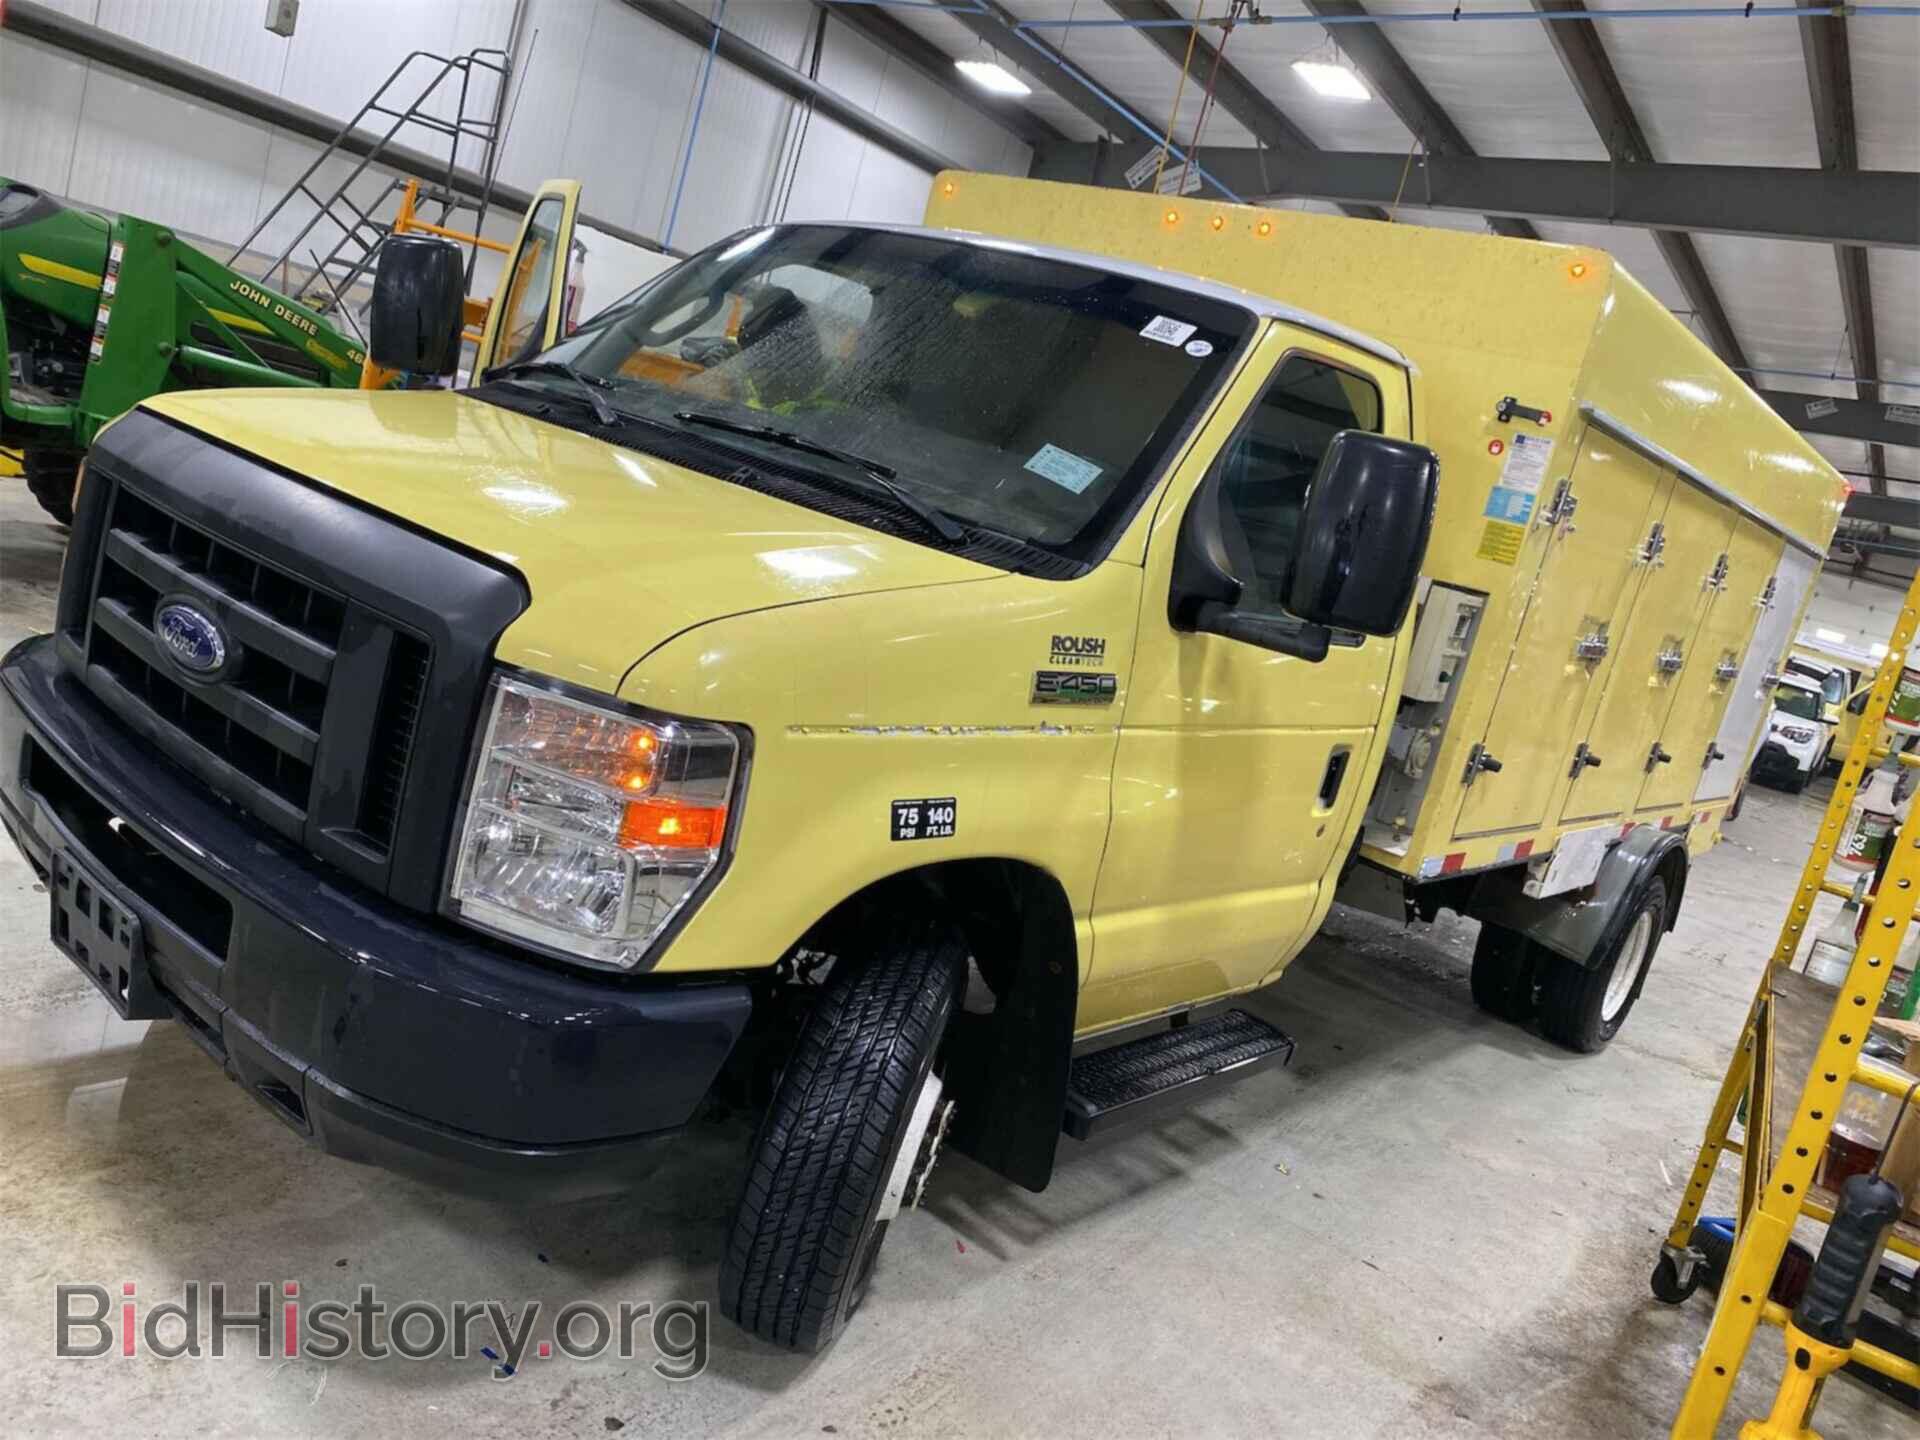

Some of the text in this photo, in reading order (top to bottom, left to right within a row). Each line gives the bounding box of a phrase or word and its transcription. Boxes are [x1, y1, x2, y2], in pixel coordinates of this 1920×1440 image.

[230, 280, 319, 336] JOHN DEERE
[1051, 635, 1105, 653] ROUSH
[898, 807, 954, 826] 75 140
[900, 827, 916, 839] PSI
